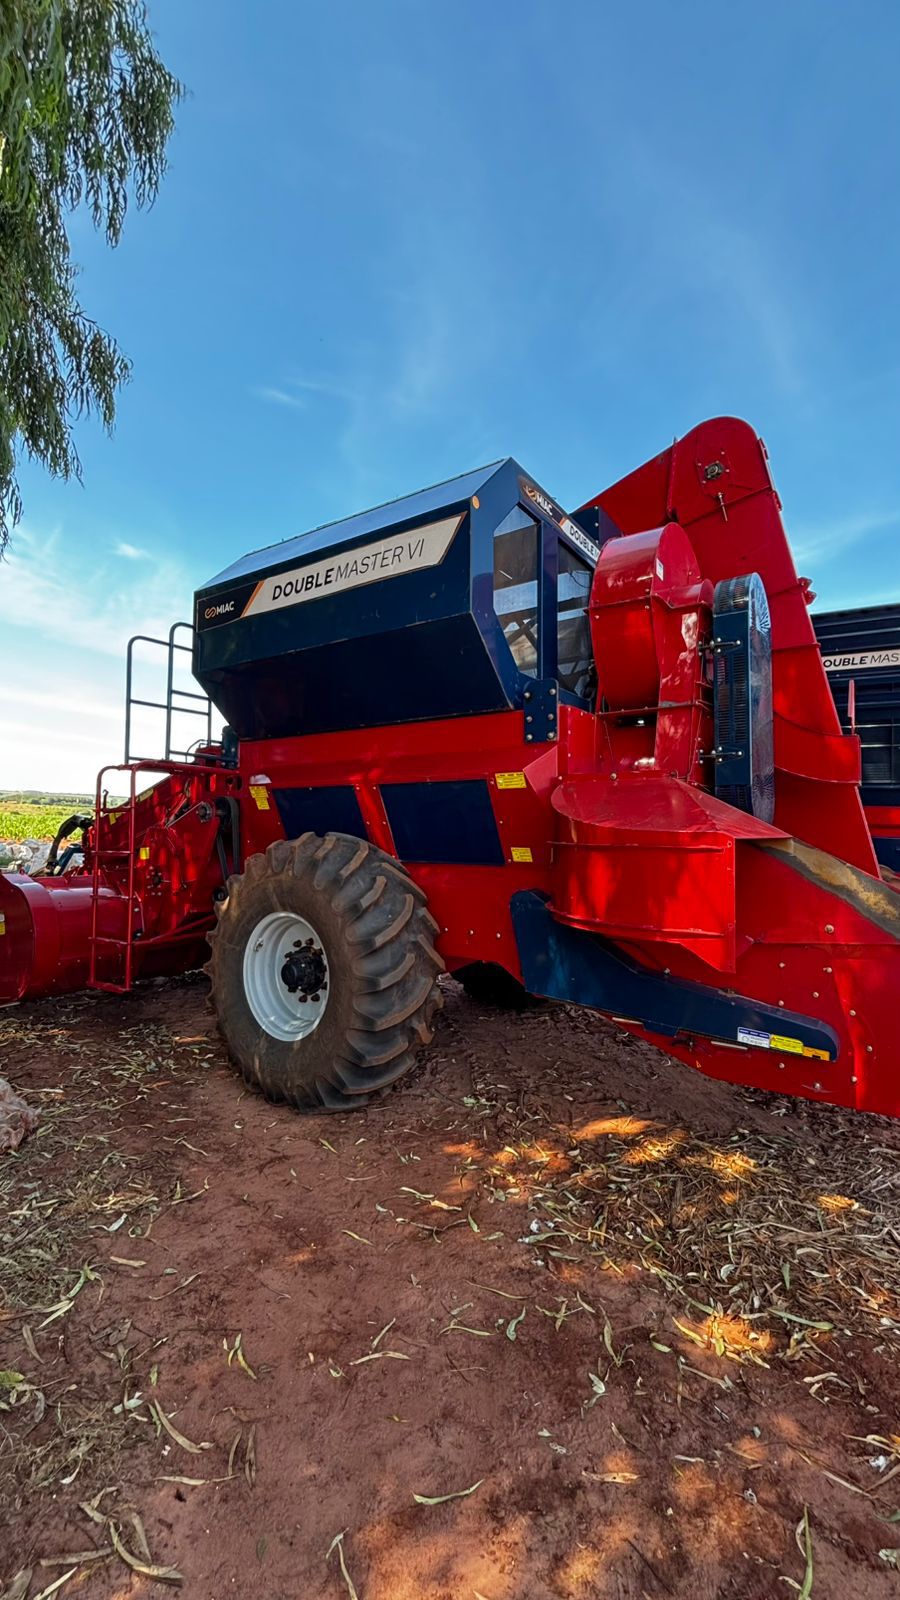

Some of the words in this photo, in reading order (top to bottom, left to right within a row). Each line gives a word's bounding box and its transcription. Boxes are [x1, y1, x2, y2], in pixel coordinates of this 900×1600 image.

[407, 538, 425, 560] VI
[216, 601, 235, 616] MIAC
[823, 655, 868, 668] OUBLE
[870, 652, 900, 664] MAS
